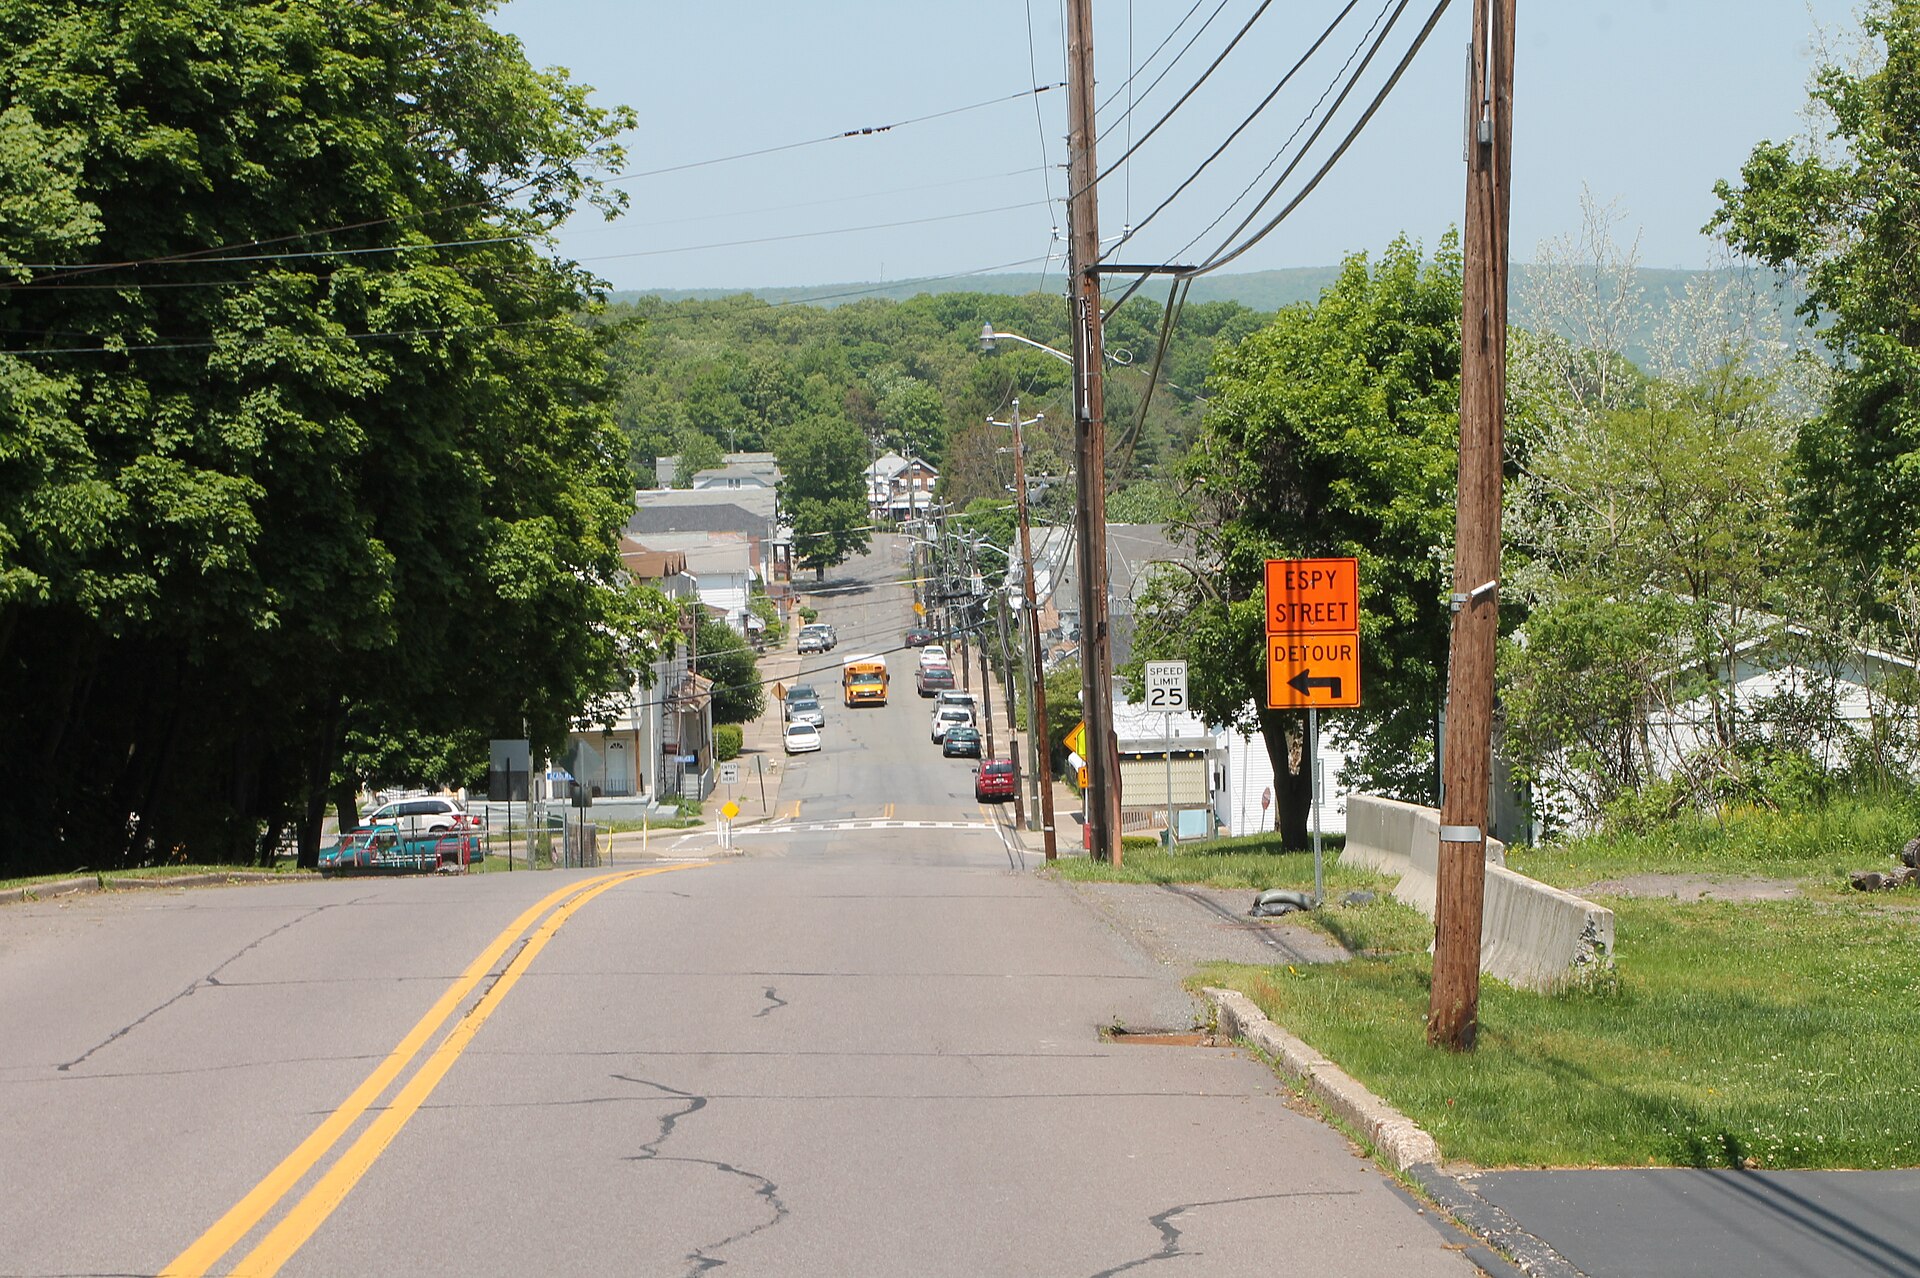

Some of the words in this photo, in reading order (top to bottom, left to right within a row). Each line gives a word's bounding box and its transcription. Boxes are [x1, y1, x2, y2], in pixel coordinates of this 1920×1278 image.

[1285, 570, 1337, 590] ESPY
[1275, 602, 1348, 623] STREET
[1274, 645, 1351, 662] DETOUR
[1149, 667, 1183, 676] SPEED
[1153, 677, 1179, 686] LIMIT
[1151, 688, 1183, 706] 25
